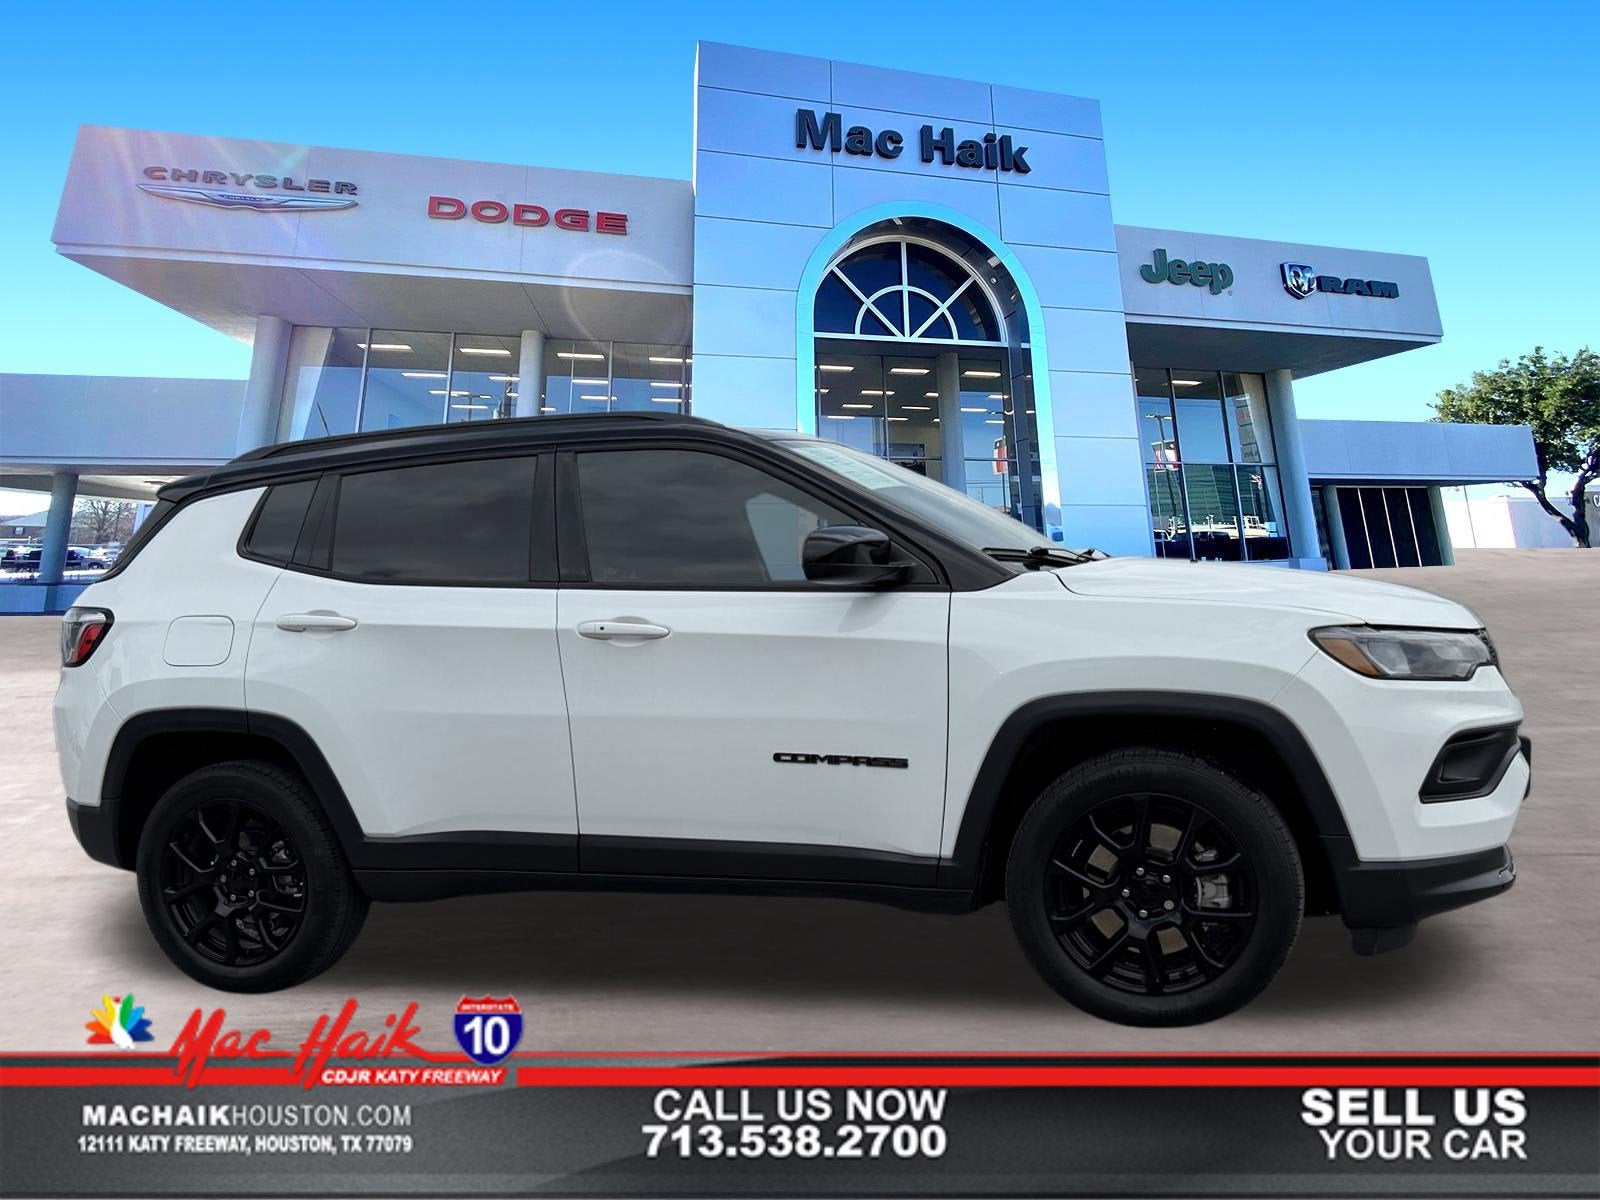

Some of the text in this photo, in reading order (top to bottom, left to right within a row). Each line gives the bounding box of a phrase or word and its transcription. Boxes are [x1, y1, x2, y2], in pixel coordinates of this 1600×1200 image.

[795, 108, 1032, 175] Mac Haik
[143, 166, 358, 196] CHRYSLER
[428, 195, 628, 236] DODGE
[1140, 248, 1234, 296] Jeep
[1316, 275, 1399, 299] RAM
[773, 752, 909, 769] COMPASS
